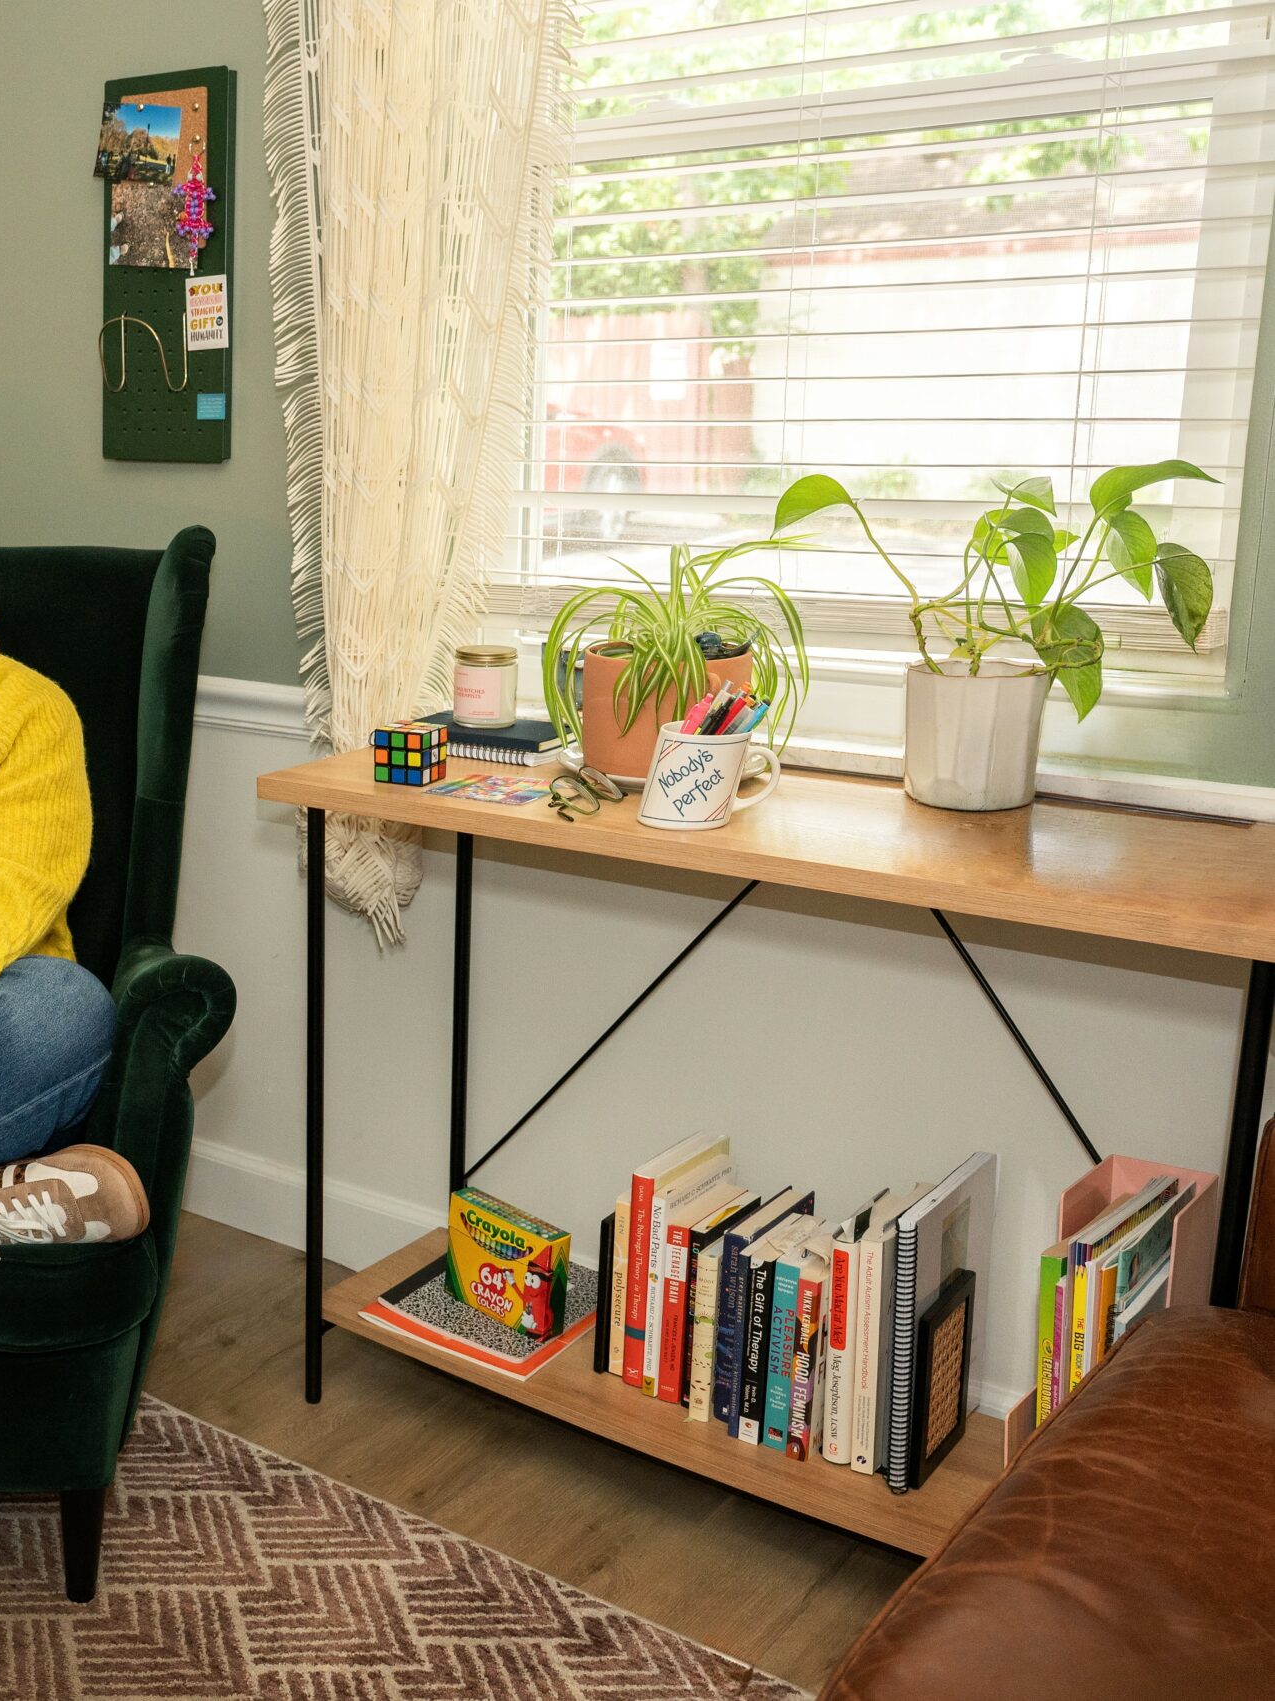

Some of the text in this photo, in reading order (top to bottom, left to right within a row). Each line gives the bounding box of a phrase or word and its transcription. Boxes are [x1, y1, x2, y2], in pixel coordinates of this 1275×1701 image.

[190, 282, 222, 296] YOU
[191, 306, 215, 317] STRAIGHT
[190, 317, 215, 331] GIFT
[191, 329, 223, 342] HUMANITY
[658, 749, 713, 798] Nobody's
[673, 768, 725, 817] perfect
[637, 1209, 645, 1221] The
[466, 1209, 526, 1249] Crayola
[635, 1223, 644, 1256] Polyvagal
[651, 1205, 662, 1268] No Bad Parts
[633, 1256, 643, 1280] Theory
[669, 1230, 683, 1304] THE TEENAGE BRAIN
[835, 1256, 845, 1272] Are
[865, 1266, 873, 1284] Adult
[480, 1266, 503, 1290] 64
[727, 1246, 739, 1308] sarah wilson
[756, 1270, 767, 1290] The
[835, 1275, 845, 1290] You
[470, 1282, 513, 1312] CRAYON
[477, 1296, 505, 1317] COLORS
[613, 1271, 625, 1327] polysecure
[631, 1293, 641, 1321] Therapy
[754, 1293, 765, 1313] Gift
[834, 1295, 844, 1314] Mad
[753, 1316, 763, 1328] of
[800, 1290, 813, 1344] MIKKI KENDALL
[770, 1306, 783, 1375] ACTIVISM
[781, 1308, 795, 1378] PLEASURE
[833, 1326, 843, 1345] Me?
[862, 1312, 871, 1353] Assessment
[1073, 1332, 1085, 1351] BIG
[748, 1331, 762, 1373] Therapy
[831, 1354, 841, 1372] Meg
[1075, 1354, 1083, 1368] BOOK
[861, 1354, 869, 1390] Handbook
[1043, 1358, 1053, 1378] EPIC
[1075, 1370, 1081, 1380] OF
[791, 1352, 811, 1438] HOOD FEMINISM
[830, 1373, 841, 1416] Josephson,
[1041, 1378, 1052, 1402] BOOK
